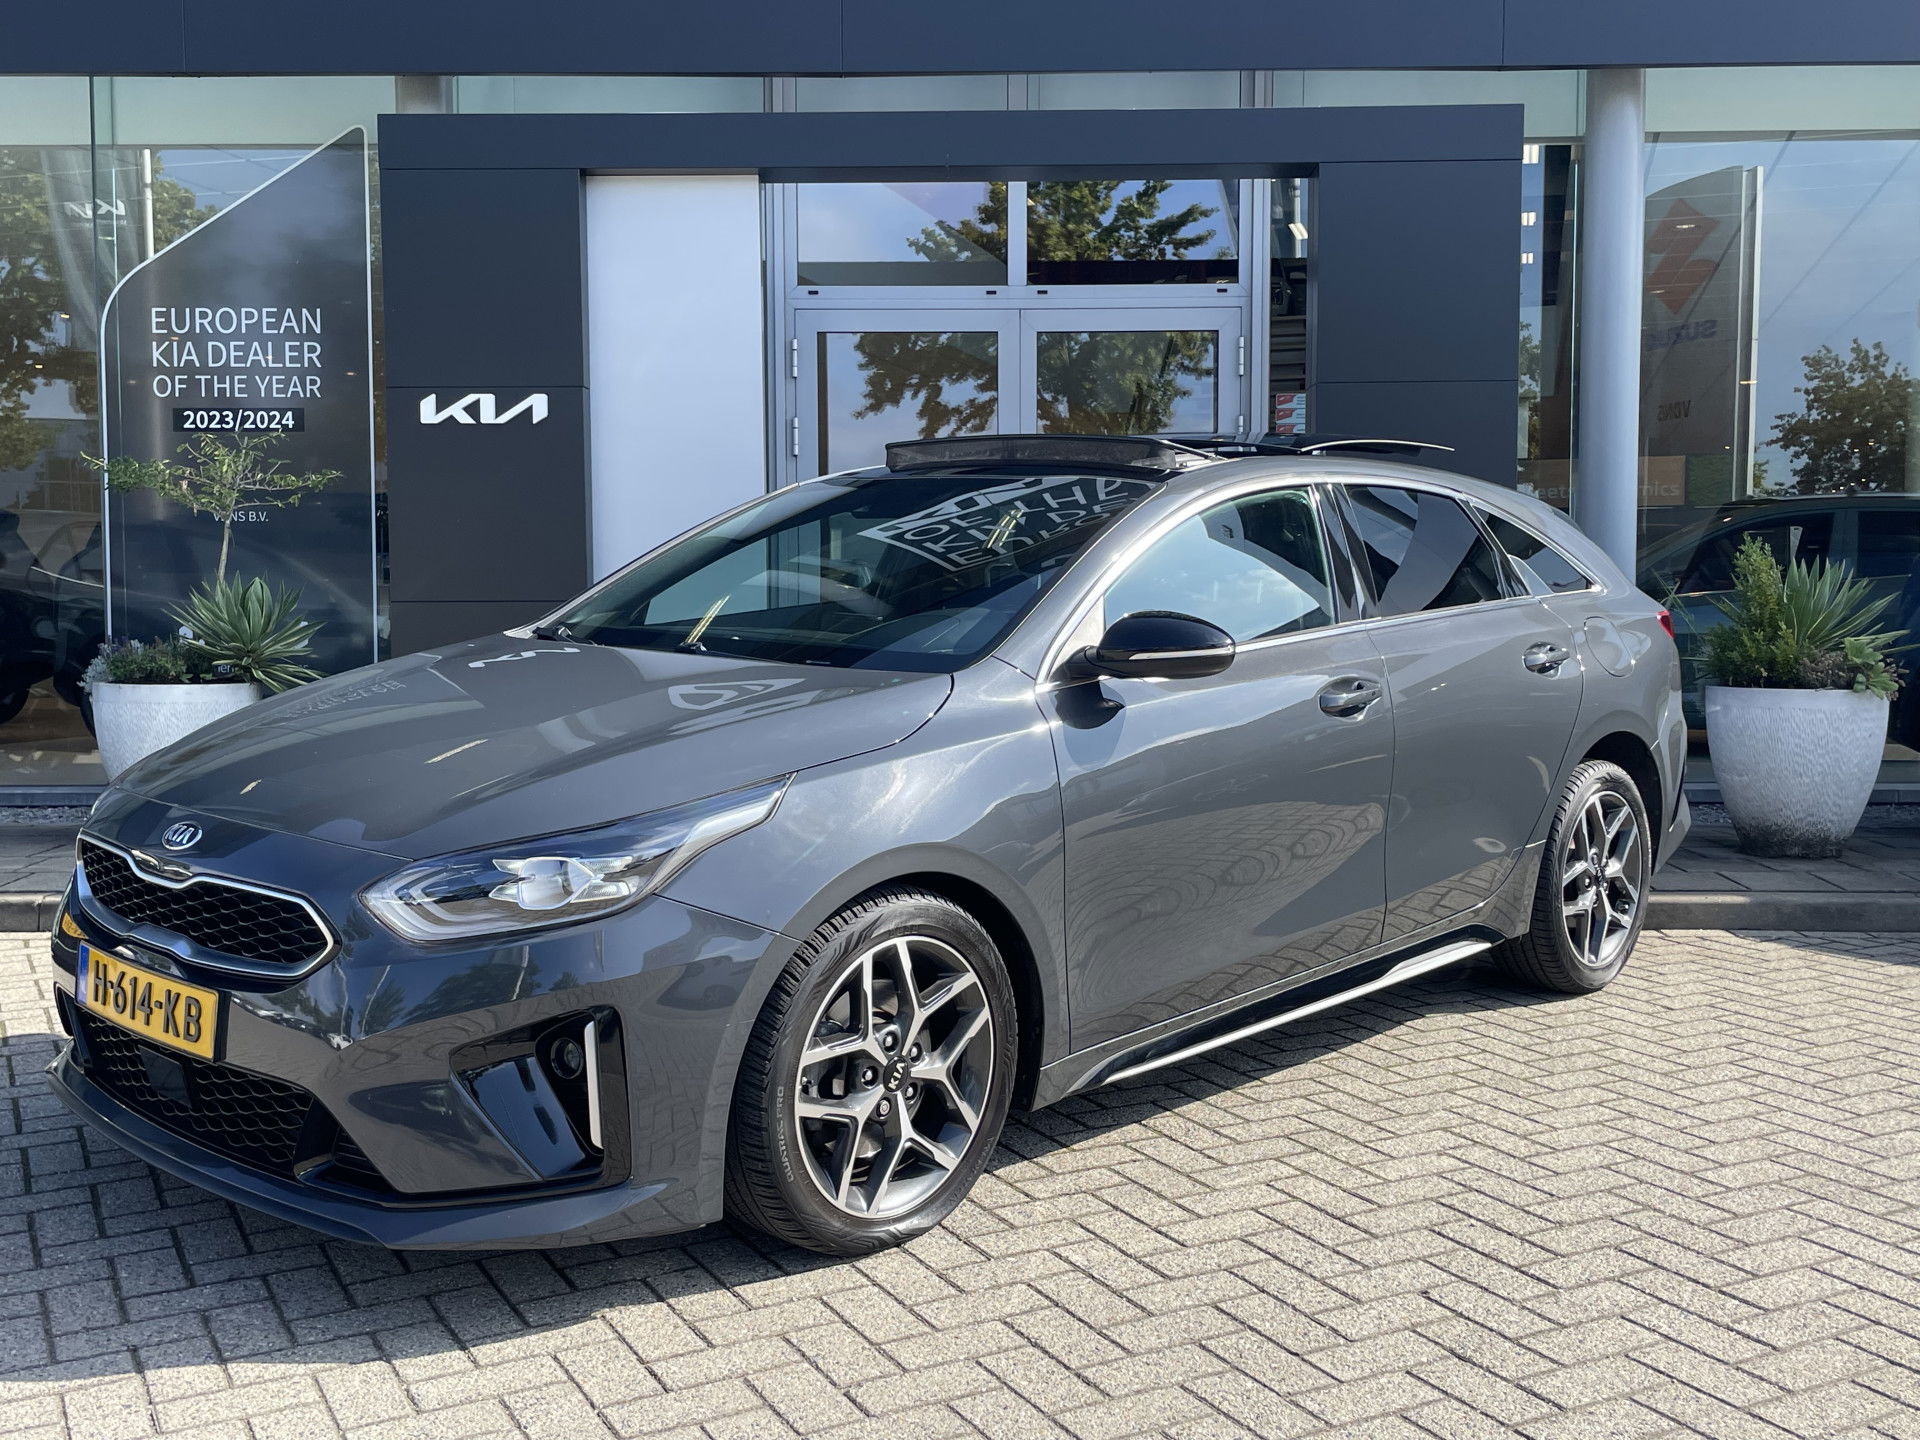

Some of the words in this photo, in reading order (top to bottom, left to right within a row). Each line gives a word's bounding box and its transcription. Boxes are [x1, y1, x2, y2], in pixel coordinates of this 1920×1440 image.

[151, 307, 322, 334] EUROPEAN
[152, 341, 200, 367] KIA
[207, 341, 322, 367] DEALER
[152, 374, 188, 398] OF
[195, 375, 248, 398] THE
[255, 375, 322, 398] YEAR
[183, 409, 295, 432] 2023/2024
[420, 393, 548, 424] KIA
[213, 510, 246, 522] VNS
[248, 511, 269, 522] B.V.
[164, 824, 195, 845] KIA
[94, 960, 203, 1044] H-614-KB
[888, 1063, 905, 1090] KIA
